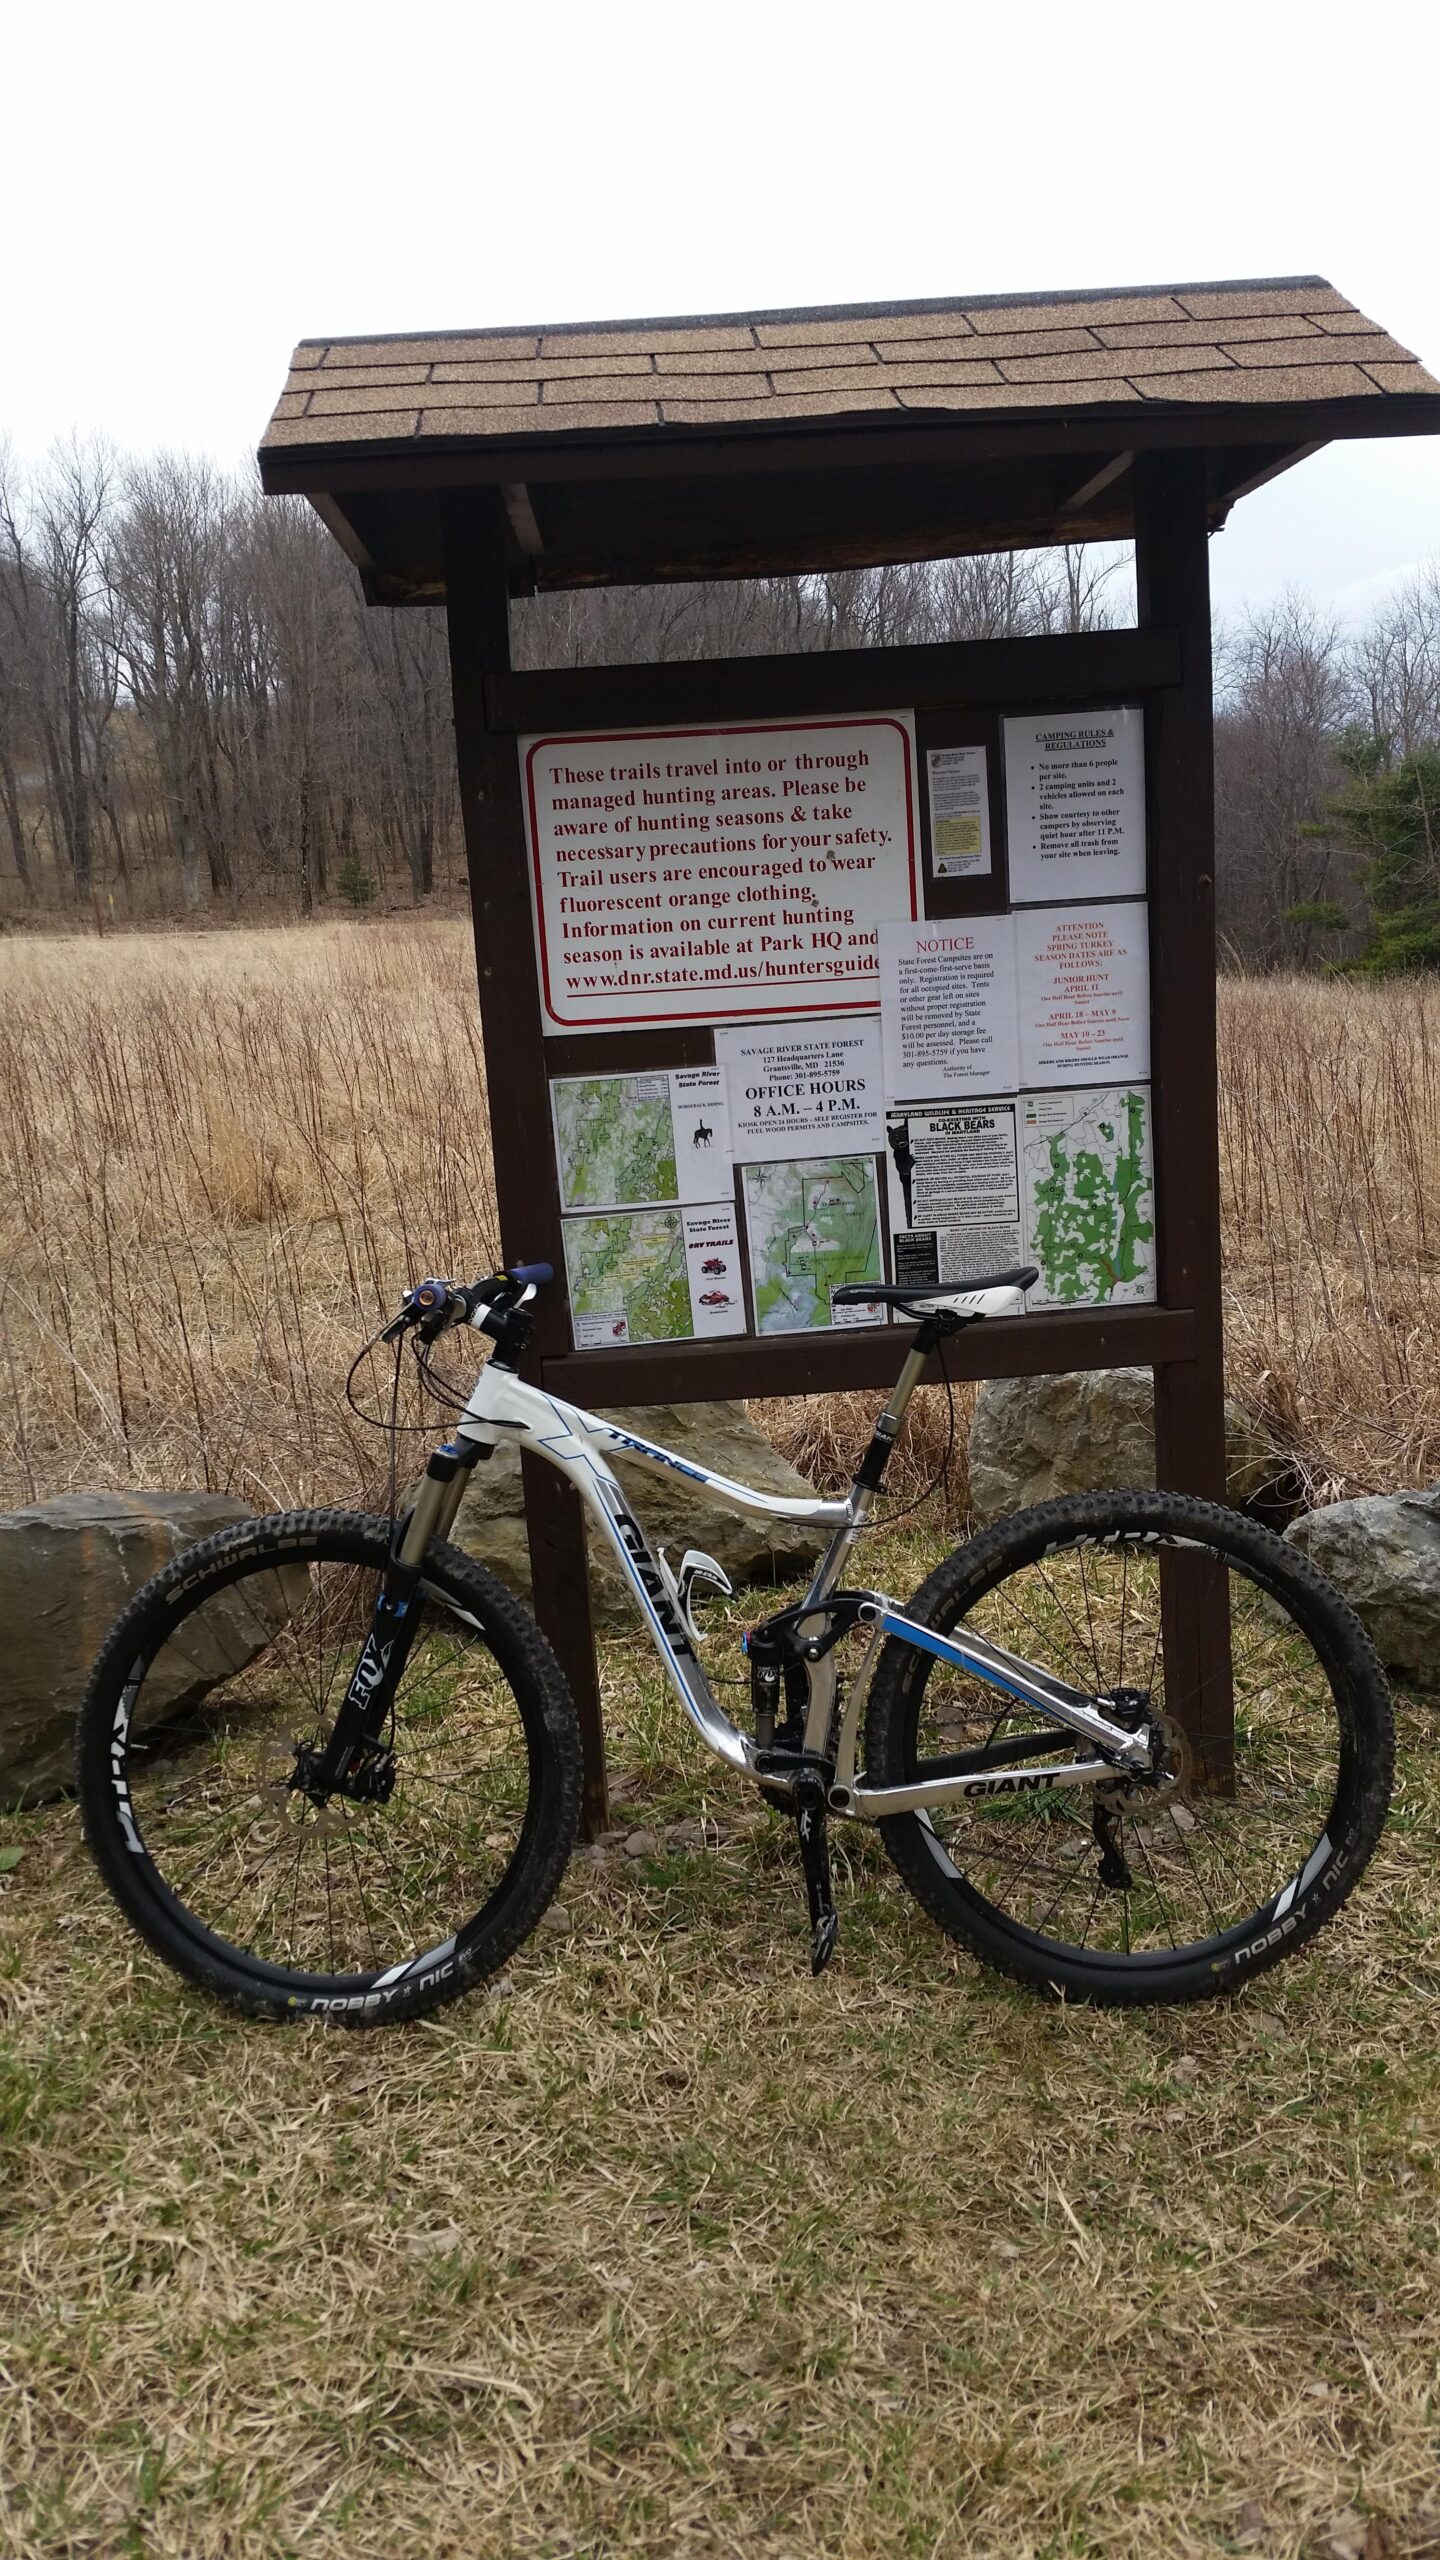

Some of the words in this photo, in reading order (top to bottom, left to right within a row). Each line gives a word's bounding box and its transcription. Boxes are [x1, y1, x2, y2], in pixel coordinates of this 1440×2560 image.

[1036, 730, 1076, 741] CAMPING
[1079, 730, 1106, 738] RULES
[1045, 739, 1106, 750] REGULATIONS
[550, 766, 604, 785] These
[610, 763, 660, 781] trails
[666, 759, 718, 778] travel
[726, 758, 761, 775] into
[768, 756, 786, 772] or
[796, 750, 869, 770] through
[1096, 759, 1118, 768] people
[1046, 782, 1075, 790] camping
[552, 790, 635, 812] managed
[643, 786, 715, 806] hunting
[721, 783, 775, 800] areas.
[783, 778, 839, 798] Please
[845, 777, 866, 793] be
[554, 819, 608, 836] aware
[614, 816, 632, 834] of
[638, 812, 710, 832] hunting
[716, 808, 784, 826] seasons
[791, 806, 806, 822] &
[813, 804, 852, 820] take
[556, 844, 646, 864] necessary
[650, 837, 756, 862] precautions
[762, 833, 786, 850] for
[790, 832, 831, 853] your
[835, 828, 892, 848] safety.
[558, 871, 603, 888] Trail
[609, 867, 657, 885] users
[663, 866, 691, 882] are
[698, 857, 803, 879] encouraged
[809, 856, 826, 873] to
[832, 855, 875, 870] wear
[561, 894, 662, 913] fluorescent
[668, 889, 730, 908] orange
[737, 884, 815, 904] clothing.
[562, 918, 673, 939] Information
[680, 917, 700, 932] on
[708, 911, 776, 930] current
[783, 907, 854, 928] hunting
[1056, 922, 1104, 932] ATTENTION
[1052, 933, 1083, 942] PLEASE
[564, 948, 622, 964] season
[629, 942, 644, 960] is
[650, 938, 730, 958] available
[736, 937, 753, 954] at
[760, 934, 804, 952] Park
[811, 932, 842, 951] HQ
[848, 928, 879, 946] and
[916, 937, 974, 953] NOTICE
[1047, 942, 1077, 951] SPRING
[1080, 940, 1113, 949] TURKEY
[899, 958, 914, 966] State
[938, 955, 971, 963] Campsites
[1035, 952, 1066, 961] SEASON
[1069, 951, 1095, 959] DATES
[905, 963, 972, 974] first-come-first-serve
[1060, 961, 1102, 969] FOLLOWS:
[899, 977, 916, 985] only.
[920, 974, 958, 983] Registration
[967, 971, 994, 980] required
[1053, 975, 1084, 984] JUNIOR
[921, 983, 949, 992] occupied
[1065, 985, 1089, 993] APRIL
[741, 1047, 774, 1056] SAVAGE
[776, 1045, 802, 1053] RIVER
[804, 1042, 830, 1051] STATE
[832, 1040, 864, 1048] FOREST
[777, 1053, 824, 1063] Headquarters
[764, 1064, 804, 1072] Grantsville,
[824, 1060, 844, 1068] 21536
[795, 1070, 840, 1079] 301-895-5759
[746, 1084, 805, 1100] OFFICE
[810, 1078, 865, 1095] HOURS
[754, 1106, 761, 1117] 8
[766, 1103, 799, 1116] A.M.
[816, 1101, 823, 1112] 4
[828, 1098, 860, 1111] P.M.
[832, 1113, 862, 1121] REGISTER
[788, 1124, 815, 1132] PERMITS
[832, 1120, 869, 1128] CAMPSITES.
[930, 1122, 961, 1132] BLACK
[964, 1119, 995, 1130] BEARS
[706, 1239, 734, 1247] TRAILS
[165, 1536, 318, 1605] SCHWALBE
[614, 1513, 698, 1663] GIANT
[348, 1633, 390, 1710] FOX
[964, 1773, 1060, 1798] GIANT
